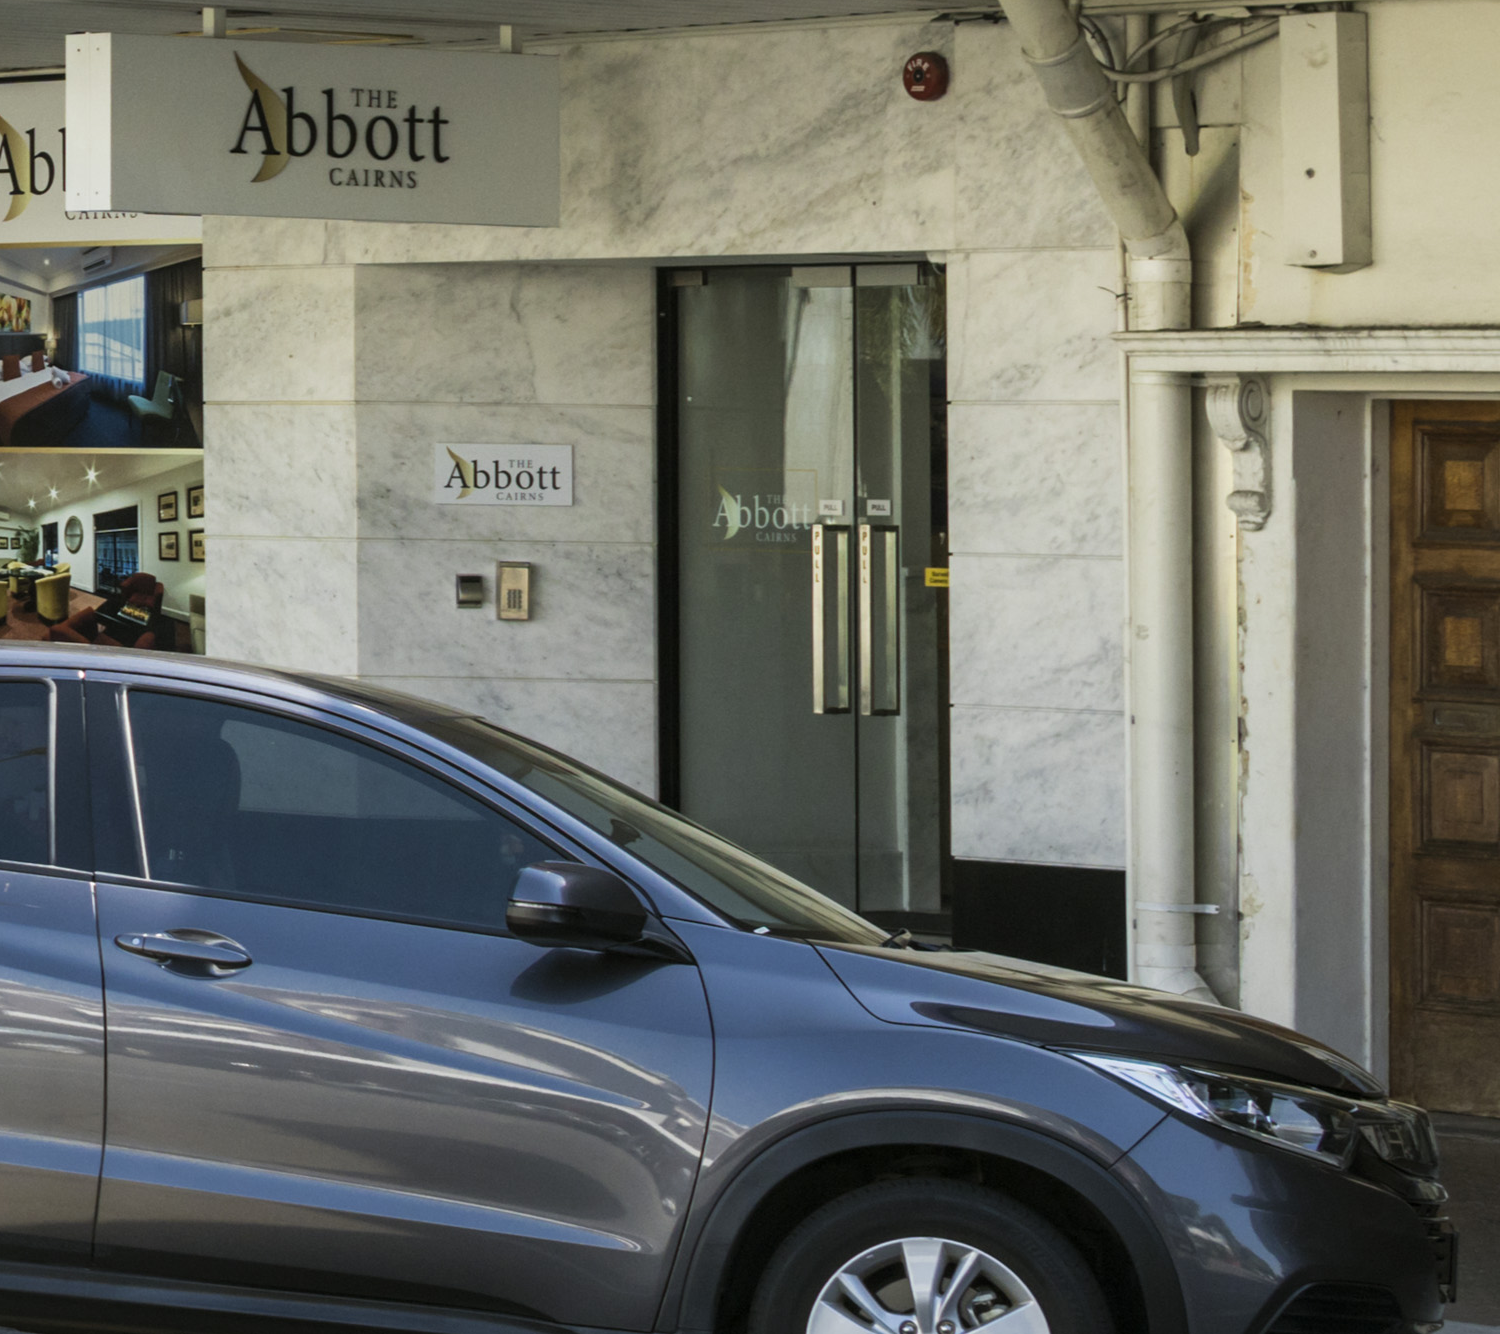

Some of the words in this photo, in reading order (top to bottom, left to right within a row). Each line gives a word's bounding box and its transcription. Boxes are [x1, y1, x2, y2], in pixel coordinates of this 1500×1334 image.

[350, 86, 399, 110] THE
[228, 85, 451, 164] Abbott
[328, 167, 419, 190] CAIRNS
[443, 459, 561, 490] Abbott
[508, 459, 534, 468] THE
[495, 492, 545, 501] CAIRNS
[871, 504, 887, 512] PULL
[712, 494, 812, 530] Abbott
[755, 532, 797, 543] CAIRNS
